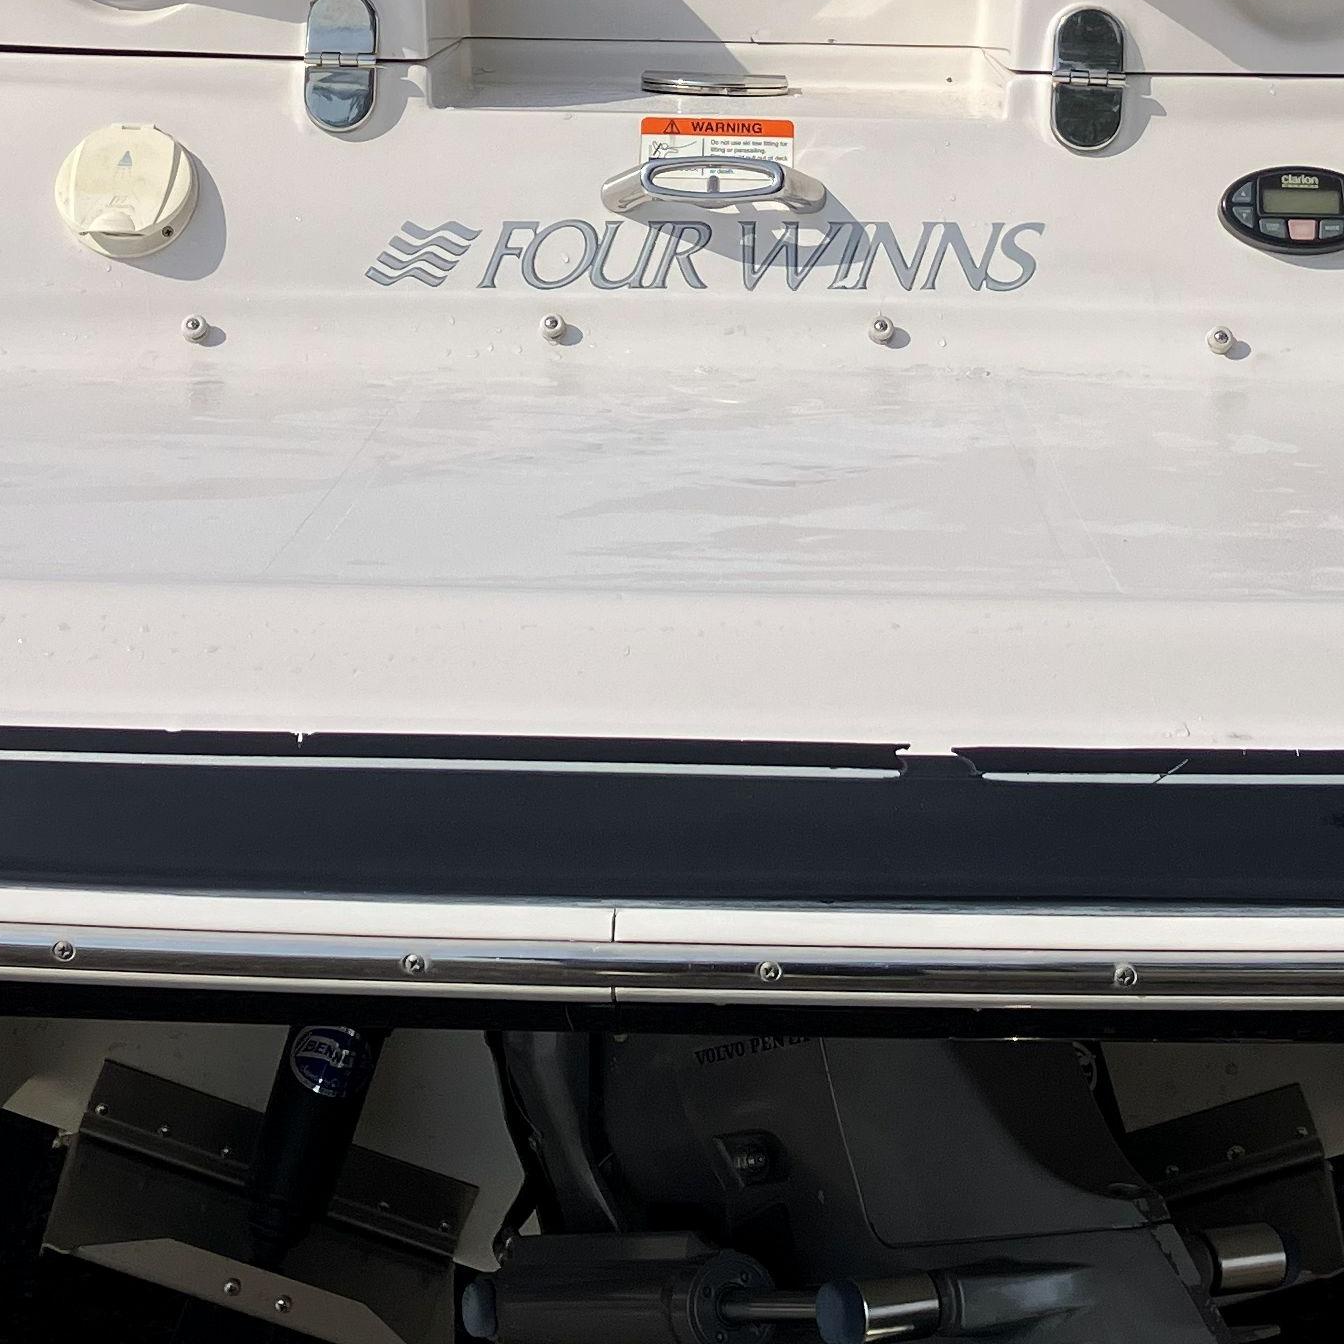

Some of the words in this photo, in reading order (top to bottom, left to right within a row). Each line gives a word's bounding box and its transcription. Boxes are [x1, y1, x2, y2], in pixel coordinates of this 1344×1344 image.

[691, 121, 763, 134] WARNING
[1281, 174, 1319, 184] clarion
[477, 219, 713, 290] FOUR
[738, 220, 1046, 292] WINNS
[695, 1041, 745, 1064] VOLVO
[750, 1034, 810, 1054] PEN
